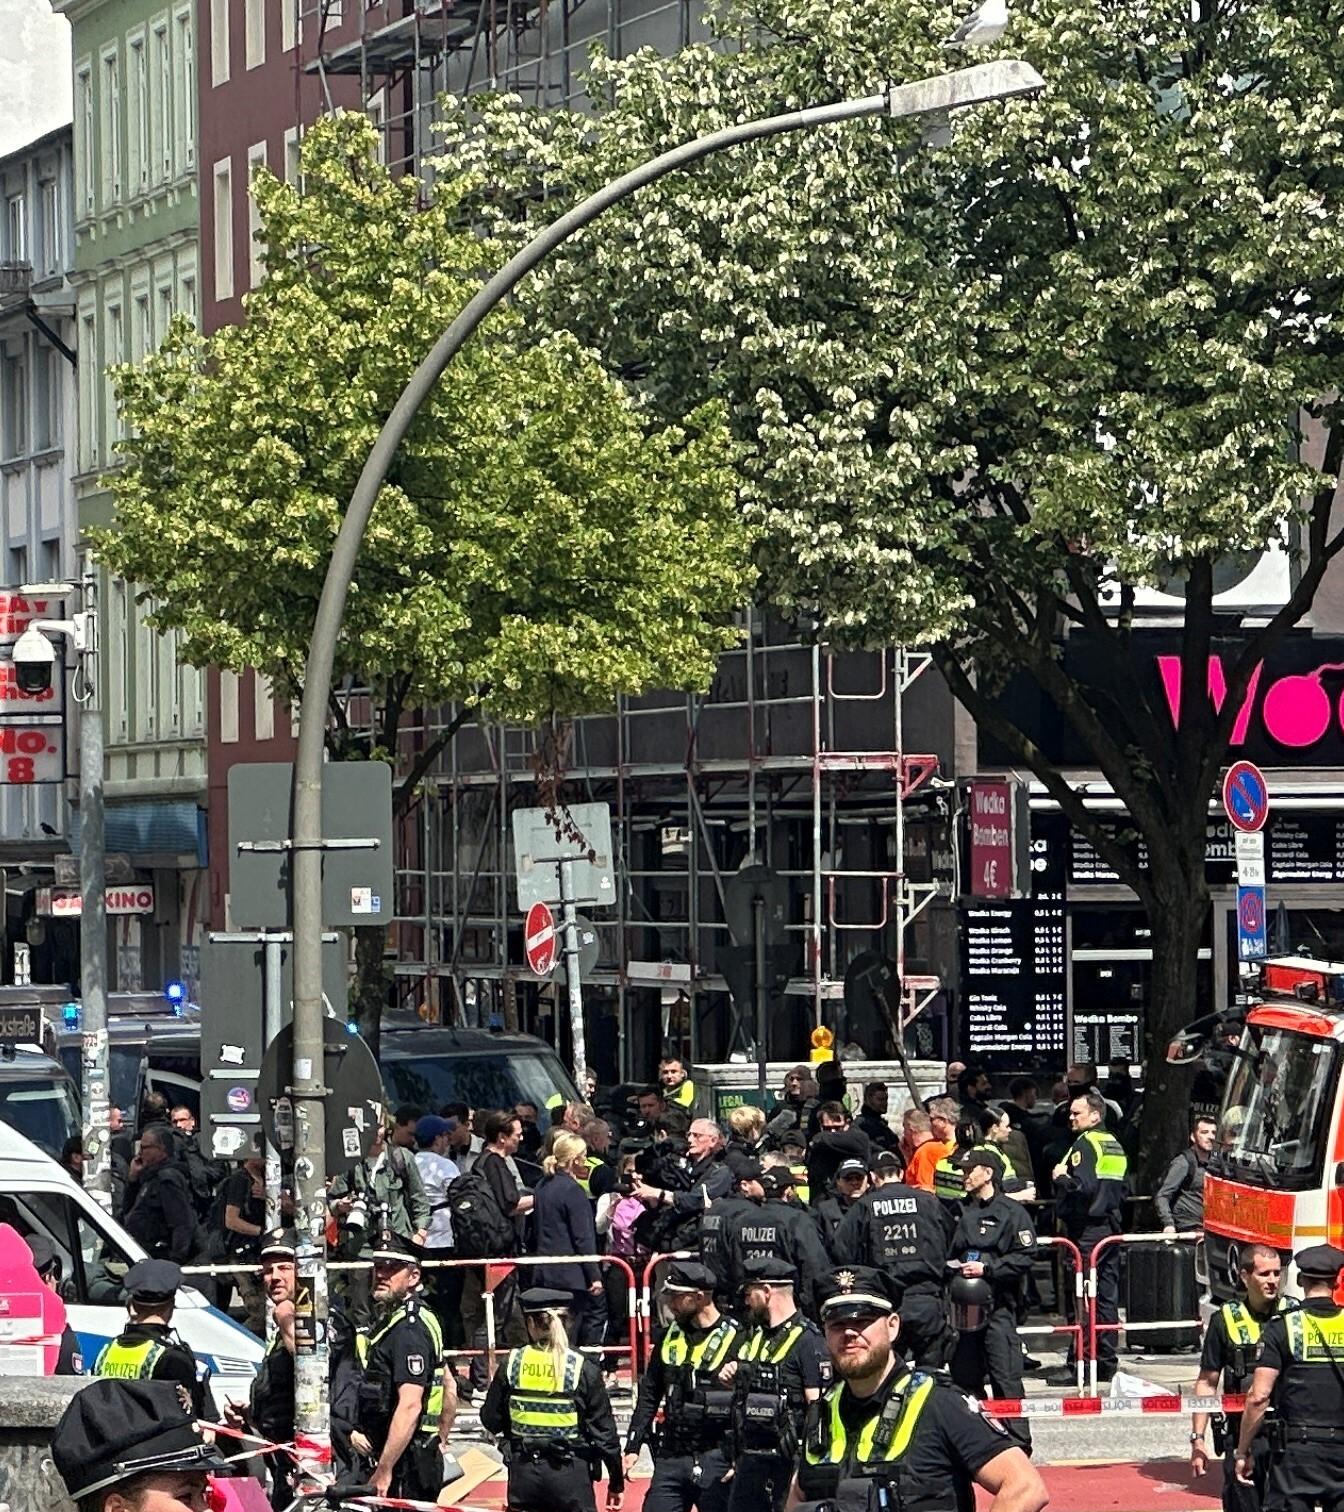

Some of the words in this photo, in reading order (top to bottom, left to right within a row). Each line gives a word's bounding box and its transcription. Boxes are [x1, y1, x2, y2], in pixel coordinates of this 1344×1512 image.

[8, 757, 35, 783] 8
[975, 791, 1005, 814] Wodka
[973, 824, 1009, 847] Bomben
[983, 860, 998, 888] 4€
[55, 893, 83, 908] GA
[105, 891, 152, 908] KINO
[872, 1197, 918, 1216] POLIZEI
[741, 1226, 776, 1243] POLIZEI
[883, 1223, 918, 1241] 2211
[103, 1361, 139, 1380] POLIZEI
[522, 1363, 555, 1378] POLIZ
